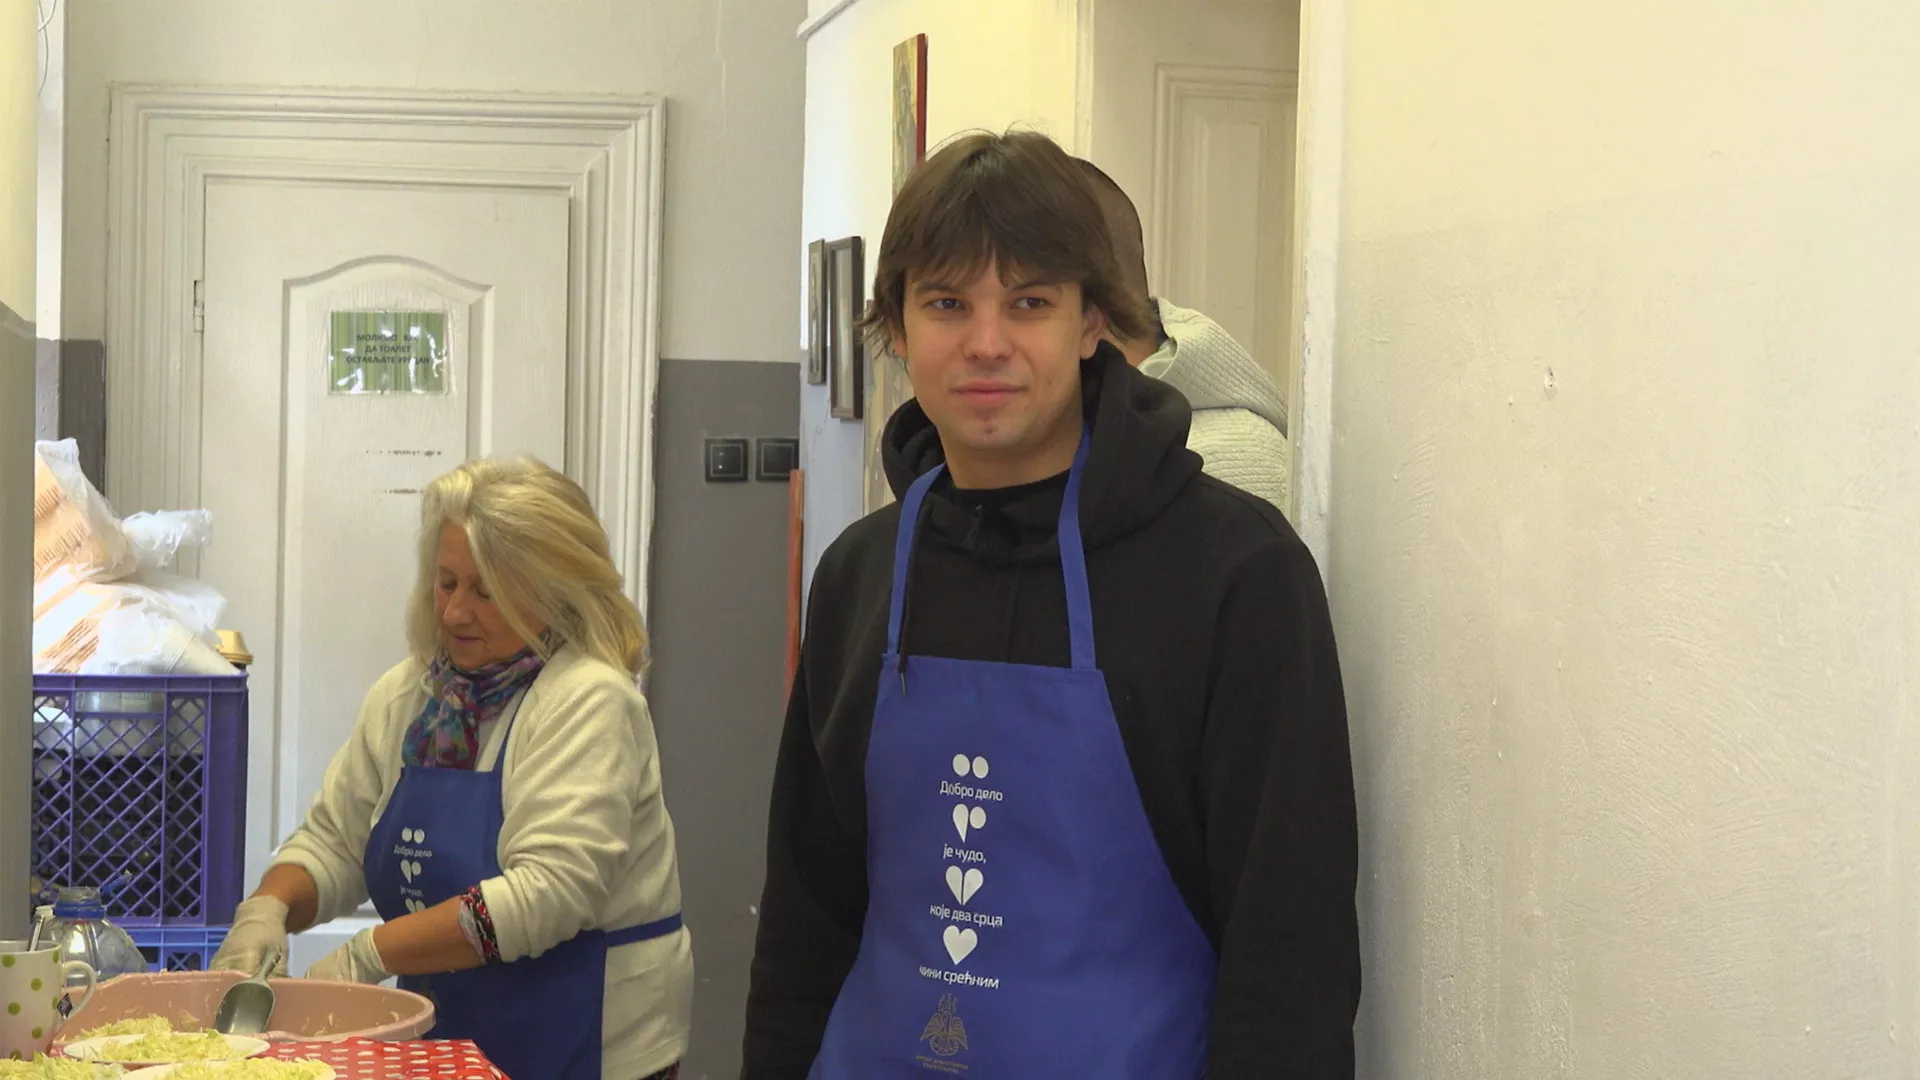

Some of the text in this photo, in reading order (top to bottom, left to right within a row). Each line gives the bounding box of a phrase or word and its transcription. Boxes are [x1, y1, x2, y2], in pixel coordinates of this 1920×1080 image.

[940, 780, 1004, 801] Добро дело
[943, 843, 987, 864] је чудо,
[929, 904, 1004, 927] које два срца
[943, 970, 1000, 989] срећним
